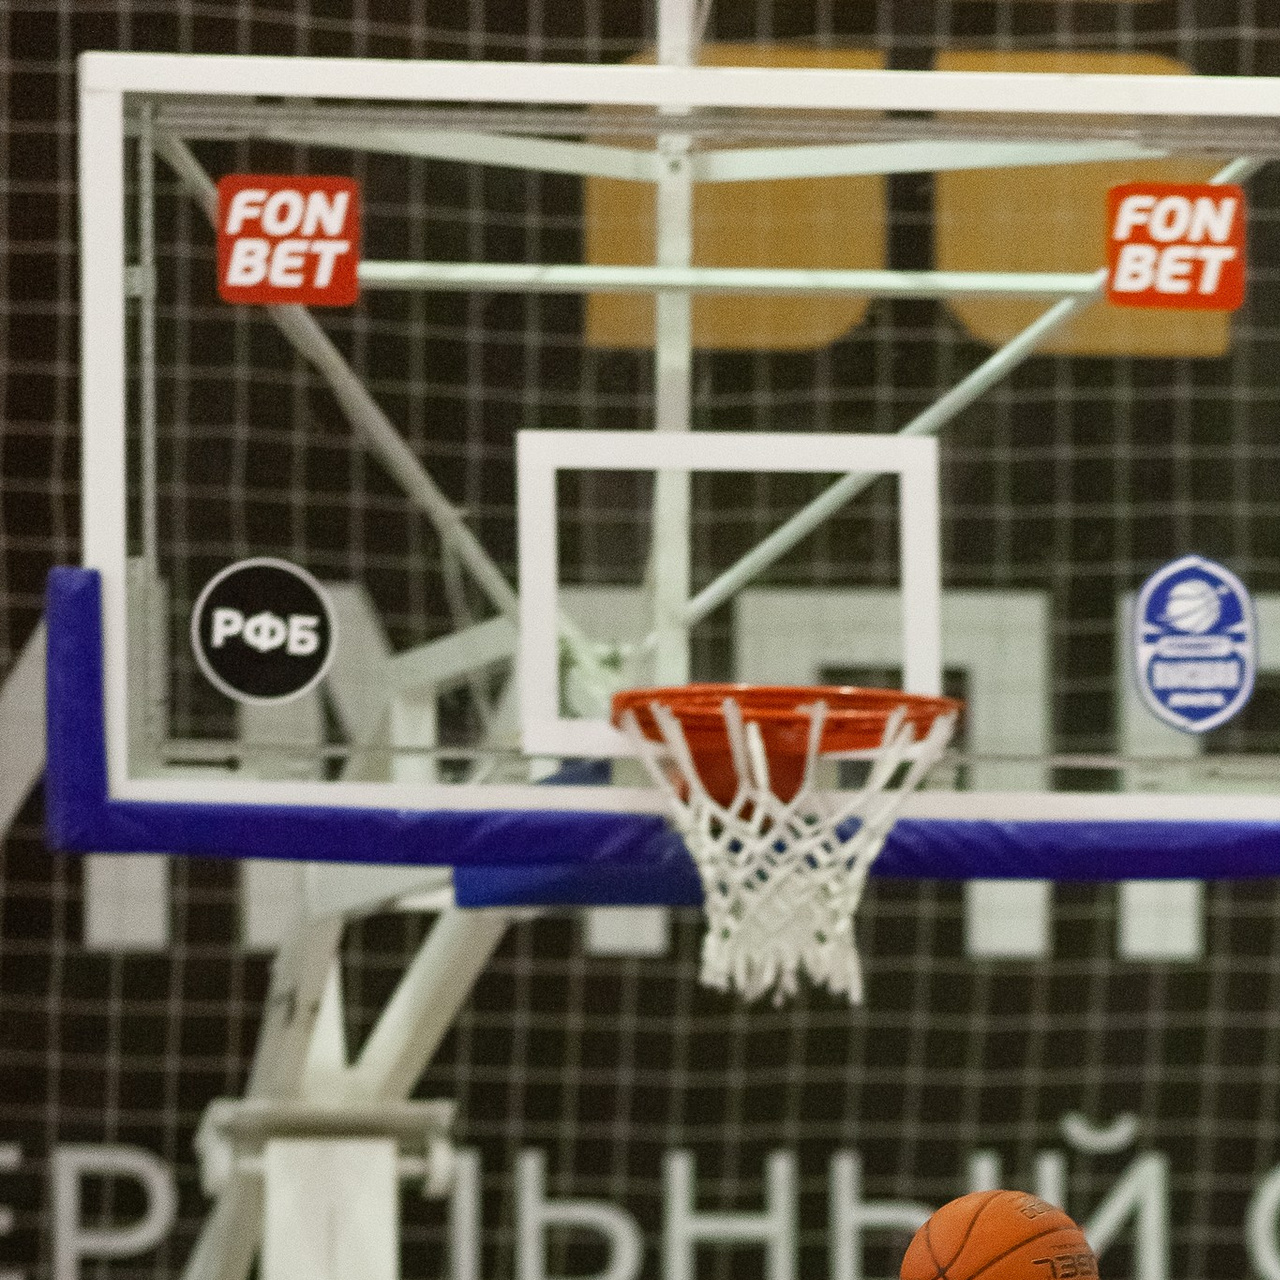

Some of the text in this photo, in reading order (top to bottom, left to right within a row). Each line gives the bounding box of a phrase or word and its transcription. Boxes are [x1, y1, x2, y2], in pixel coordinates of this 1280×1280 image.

[226, 189, 350, 236] FON
[1113, 194, 1237, 242] FON
[226, 238, 350, 289] BET
[1113, 243, 1237, 294] BET
[211, 606, 320, 657] РФБ
